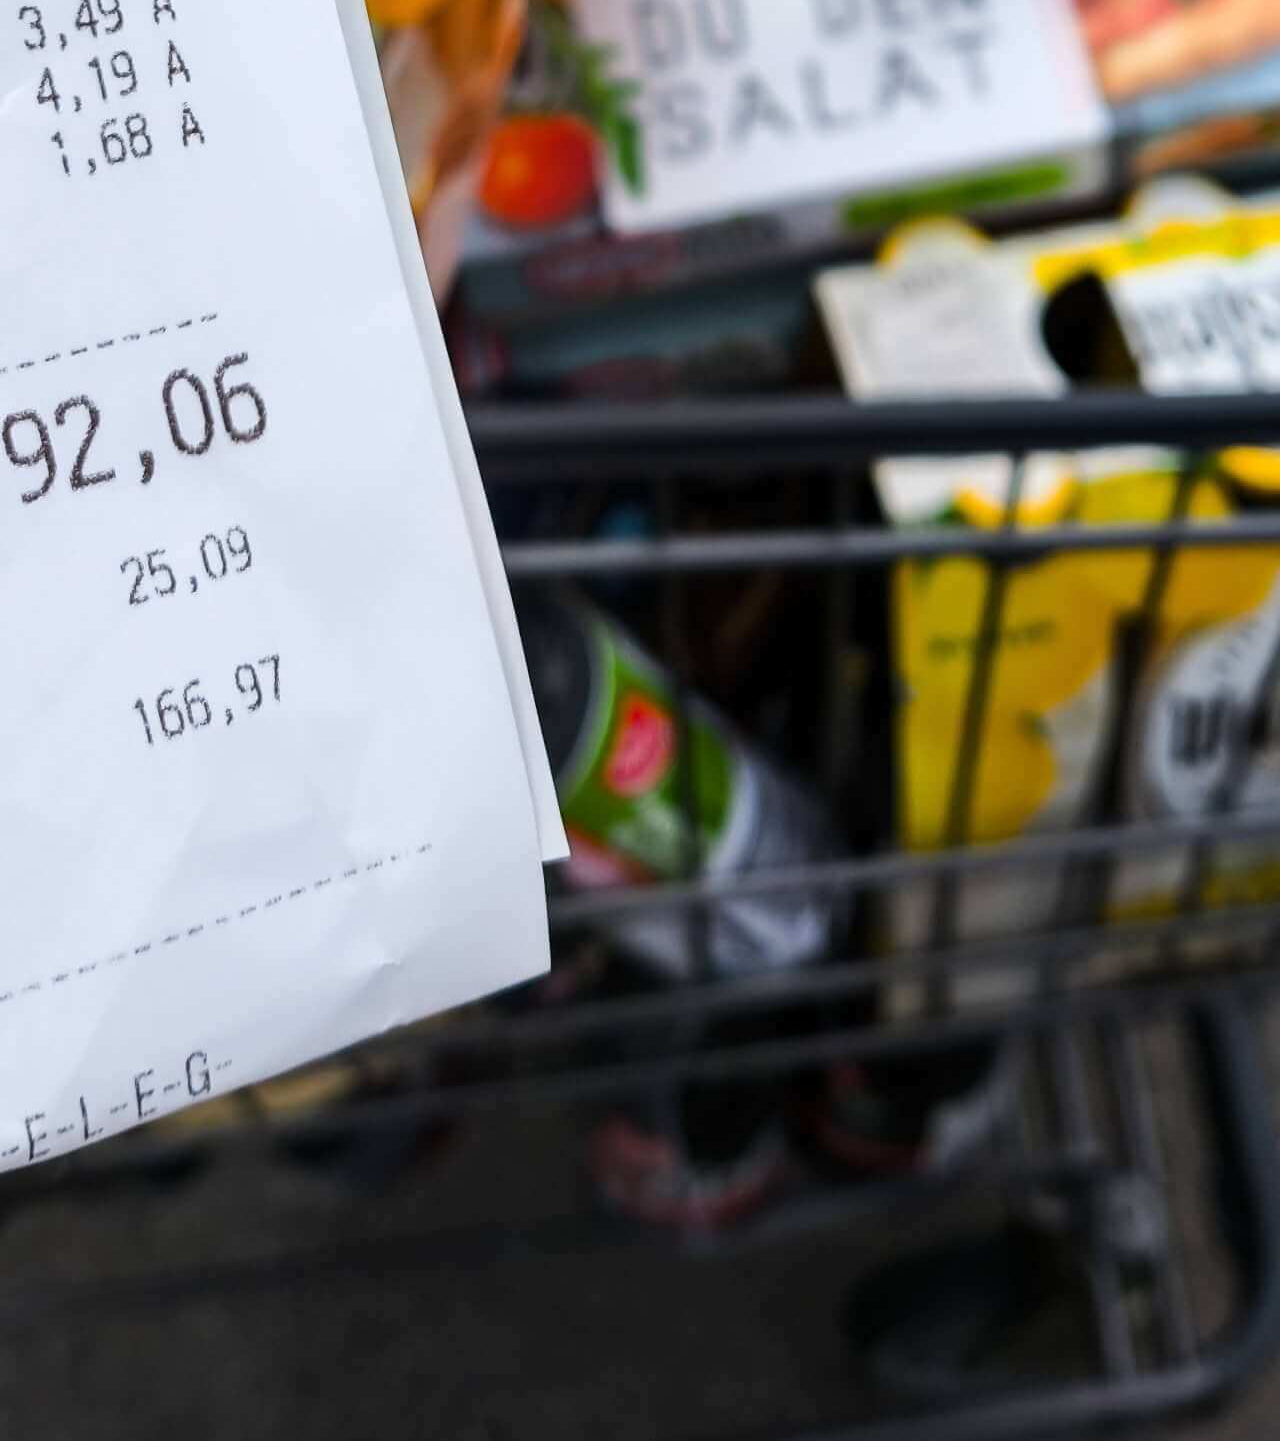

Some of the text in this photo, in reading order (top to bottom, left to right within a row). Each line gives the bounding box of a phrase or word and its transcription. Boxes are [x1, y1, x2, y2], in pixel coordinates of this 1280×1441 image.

[36, 50, 139, 113] 4,19
[166, 40, 192, 86] A
[655, 24, 992, 166] SALAT
[51, 113, 153, 177] 1,68
[180, 102, 206, 148] A
[120, 525, 252, 606] 25,09
[134, 654, 280, 745] 166,97
